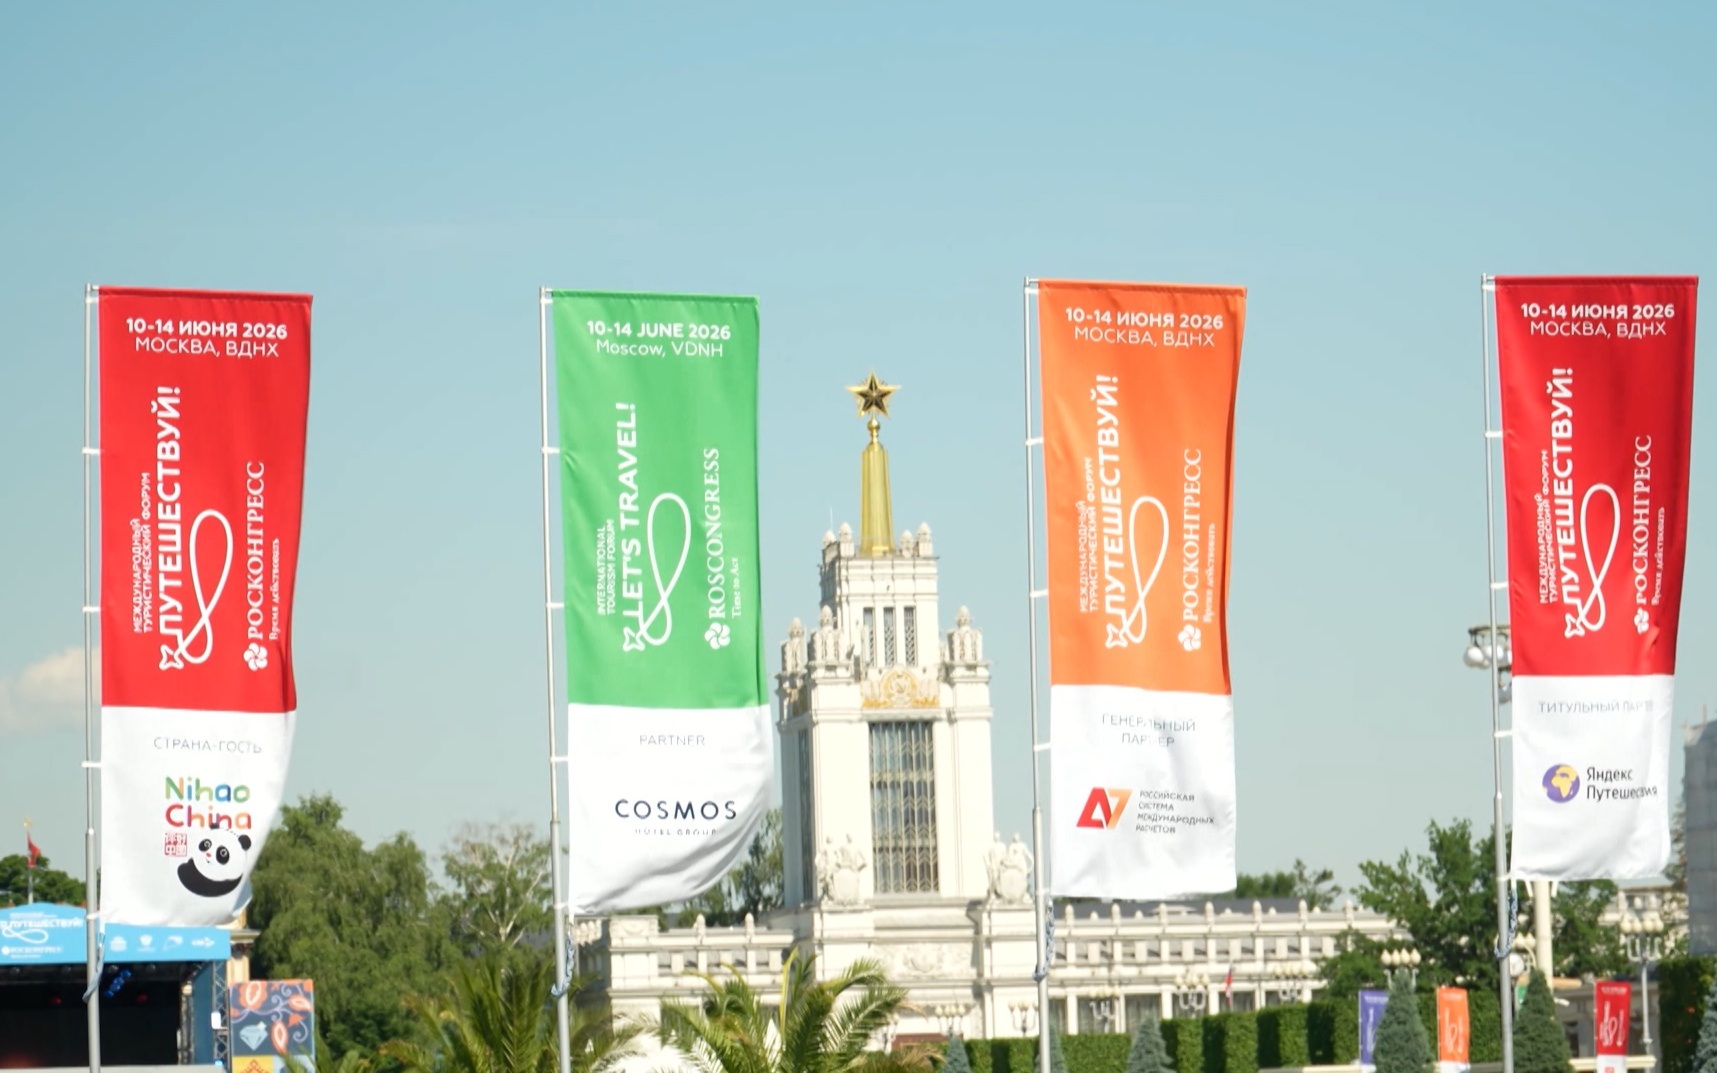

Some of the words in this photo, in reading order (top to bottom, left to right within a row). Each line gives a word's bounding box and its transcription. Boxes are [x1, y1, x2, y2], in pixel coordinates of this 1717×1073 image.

[126, 317, 175, 335] 10-14
[179, 320, 238, 337] ИЮНЯ
[242, 323, 288, 340] 2026
[587, 320, 632, 336] 10-14
[637, 322, 684, 338] JUNE
[688, 324, 732, 340] 2026
[1065, 307, 1112, 324] 10-14
[1117, 311, 1175, 327] ИЮНЯ
[1179, 314, 1224, 330] 2026
[1521, 303, 1567, 318] 10-14
[1571, 304, 1628, 319] ИЮНЯ
[1632, 303, 1675, 319] 2026
[1530, 321, 1611, 339] МОСКВА,
[1616, 321, 1667, 339] ВДНХ
[135, 337, 221, 357] МОСКВА,
[225, 340, 280, 359] ВДНХ
[596, 339, 666, 358] Moscow,
[671, 341, 723, 357] VDNH
[1074, 326, 1157, 347] МОСКВА,
[1163, 331, 1215, 348] ВДНХ
[615, 402, 640, 531] TRAVEL!
[1084, 457, 1096, 503] ФОРУМ
[1540, 449, 1550, 495] ФОРУМ
[1546, 367, 1581, 612] ПУТЕШЕСТВУЙ!
[141, 472, 152, 519] ФОРУМ
[151, 386, 183, 643] ПУТЕШЕСТВУЙ!
[1090, 375, 1126, 624] ПУТЕШЕСТВУЙ!
[606, 518, 616, 561] FORUM
[703, 447, 727, 619] ROSCONGRESS
[1182, 448, 1202, 622] РОСКОНГРЕСС
[1632, 435, 1652, 605] РОСКОНГРЕСС
[246, 461, 265, 641] РОСКОНГРЕСС
[597, 525, 607, 616] INTERNATIONAL
[1076, 501, 1088, 612] МЕЖДУНАРОДНЫЙ
[1086, 506, 1099, 612] ТУРИСТИЧЕСКИЙ
[1534, 492, 1548, 604] МЕЖДУНАРОДНЫЙ
[1542, 499, 1558, 603] ТУРИСТИЧЕСКИЙ
[130, 518, 142, 633] МЕЖДУНАРОДНЫЙ
[141, 524, 153, 633] ТУРИСТИЧЕСКИЙ
[606, 562, 616, 615] TOURISM
[621, 538, 643, 624] LET'S
[1538, 699, 1620, 713] ТИТУЛЬНЫЙ
[153, 736, 263, 754] СТРАНА-ГОСТЬ
[165, 776, 251, 803] Nihao
[1586, 766, 1634, 783] Яндекс
[165, 803, 252, 829] China
[615, 798, 737, 820] COSMOS
